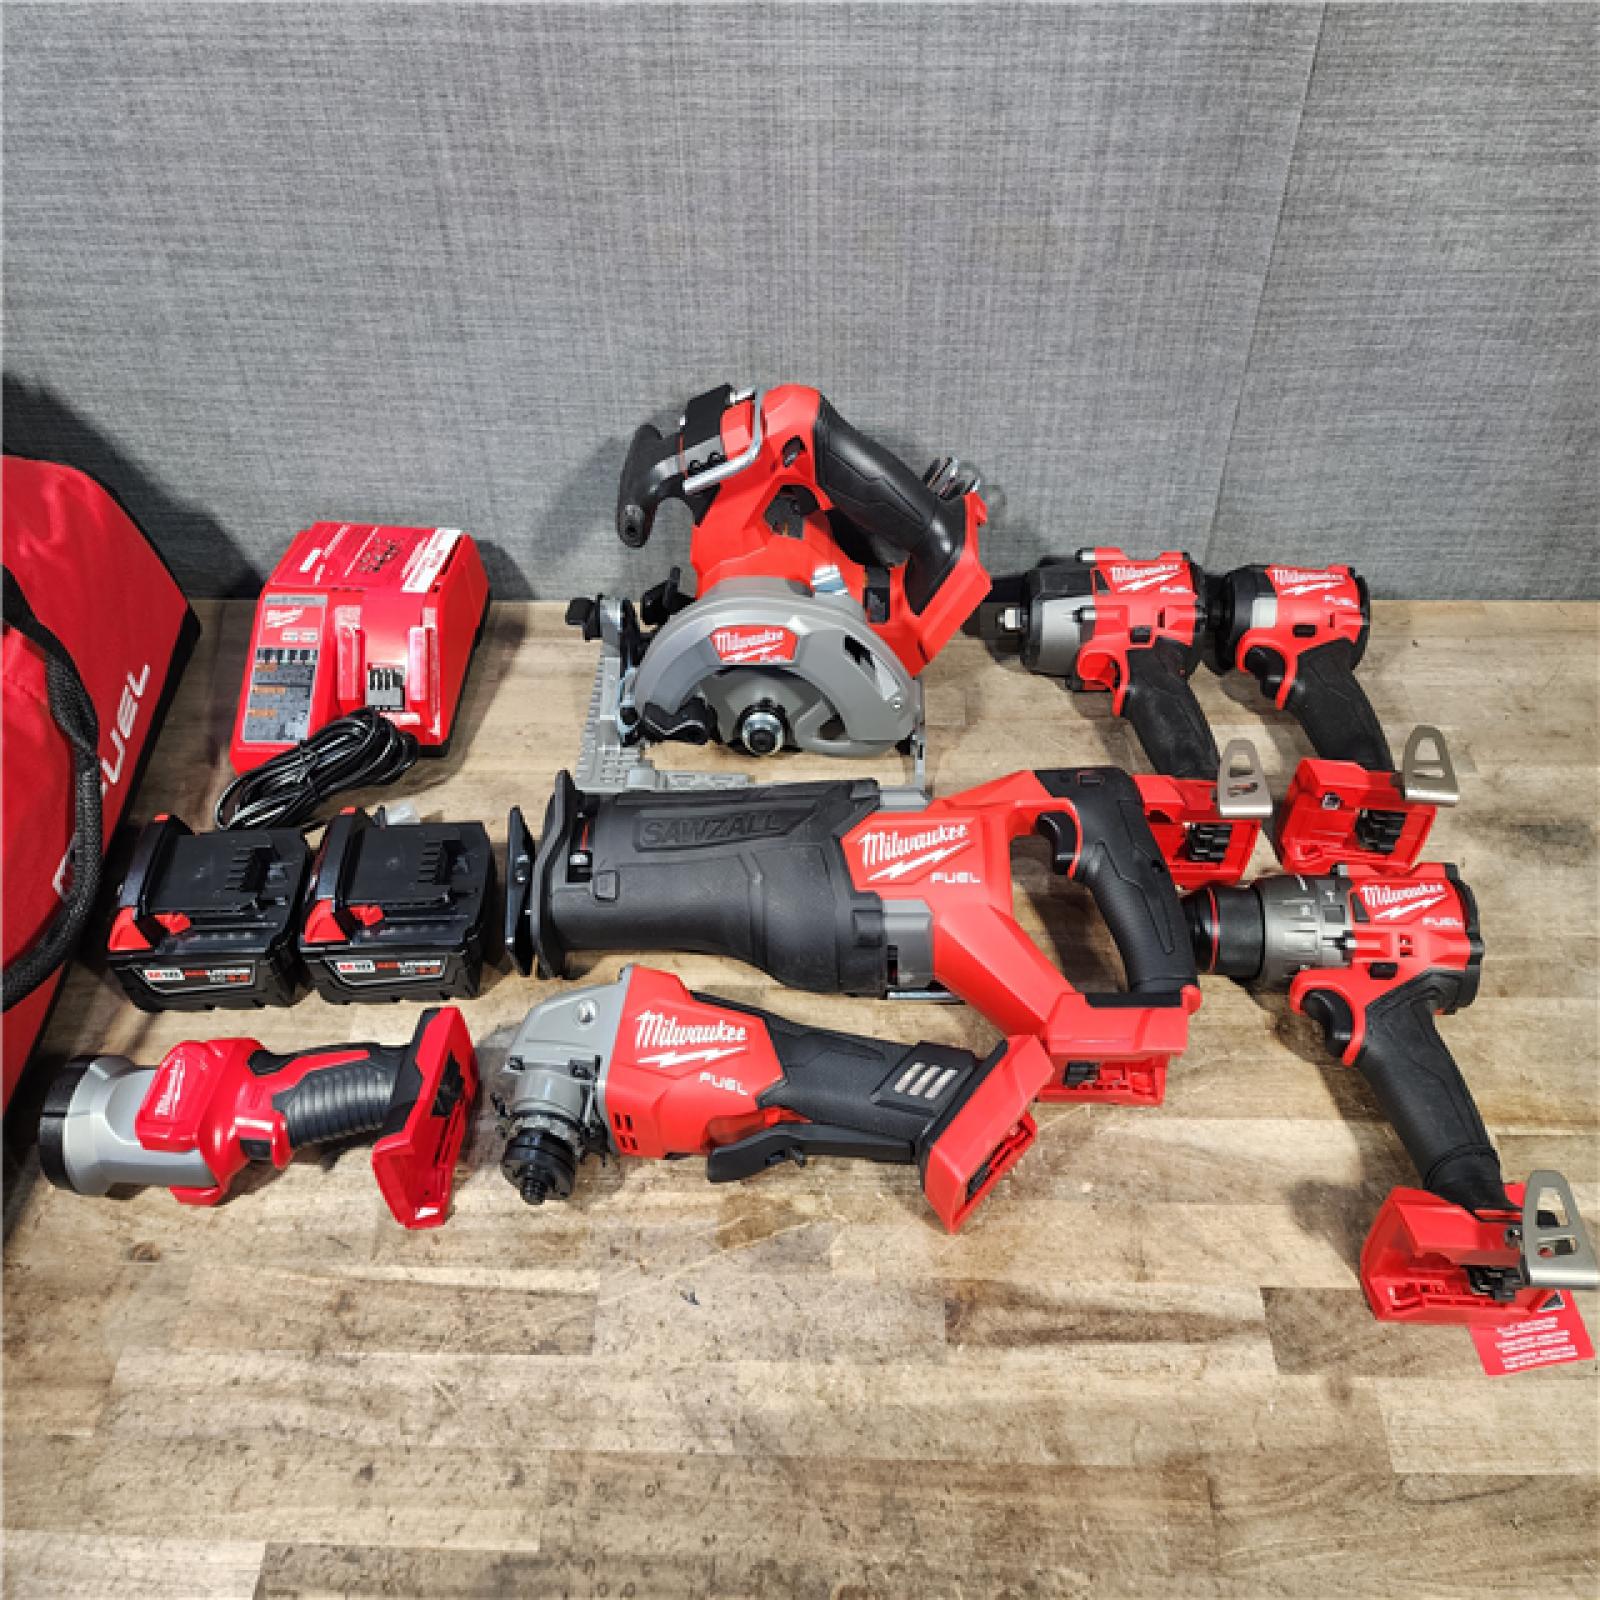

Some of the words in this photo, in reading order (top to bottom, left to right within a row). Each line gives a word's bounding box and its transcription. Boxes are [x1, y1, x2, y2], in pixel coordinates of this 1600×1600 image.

[101, 664, 151, 797] UEL
[643, 813, 781, 845] SAWZALL
[857, 824, 968, 868] Milwaukee
[930, 872, 981, 884] FUEL
[1361, 882, 1445, 908] Milwaukee
[634, 1009, 748, 1050] Milwaukee
[699, 1071, 749, 1096] FUEL
